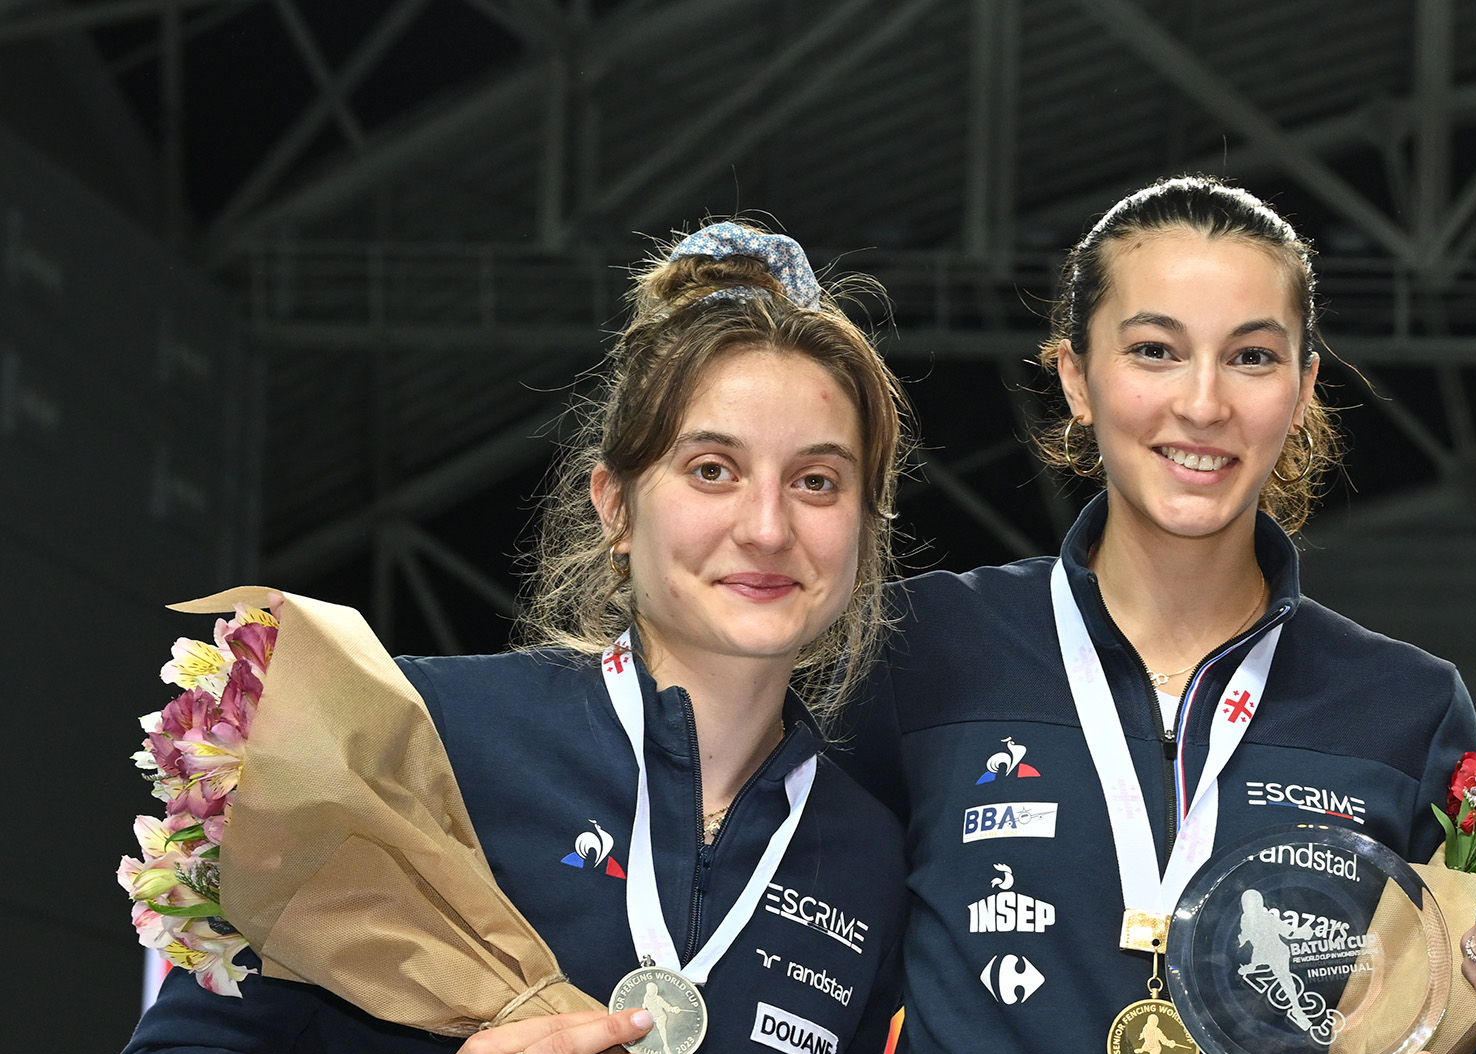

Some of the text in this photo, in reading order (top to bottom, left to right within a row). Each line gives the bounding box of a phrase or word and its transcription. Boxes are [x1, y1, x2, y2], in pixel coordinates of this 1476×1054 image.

[965, 806, 1017, 835] BBA
[1246, 782, 1366, 824] ESCRIME
[765, 882, 869, 954] ESCRIME
[967, 891, 1056, 933] INSEP
[1290, 934, 1378, 956] BATUMI CUP
[786, 961, 854, 1007] randstad
[1307, 962, 1374, 978] INDIVIDUAL
[622, 972, 653, 995] FENCING
[655, 972, 686, 991] WORLD
[685, 990, 699, 1008] CUP
[675, 1036, 695, 1054] 2023
[1113, 1024, 1126, 1054] SENIOR
[1122, 1004, 1157, 1025] FENCING
